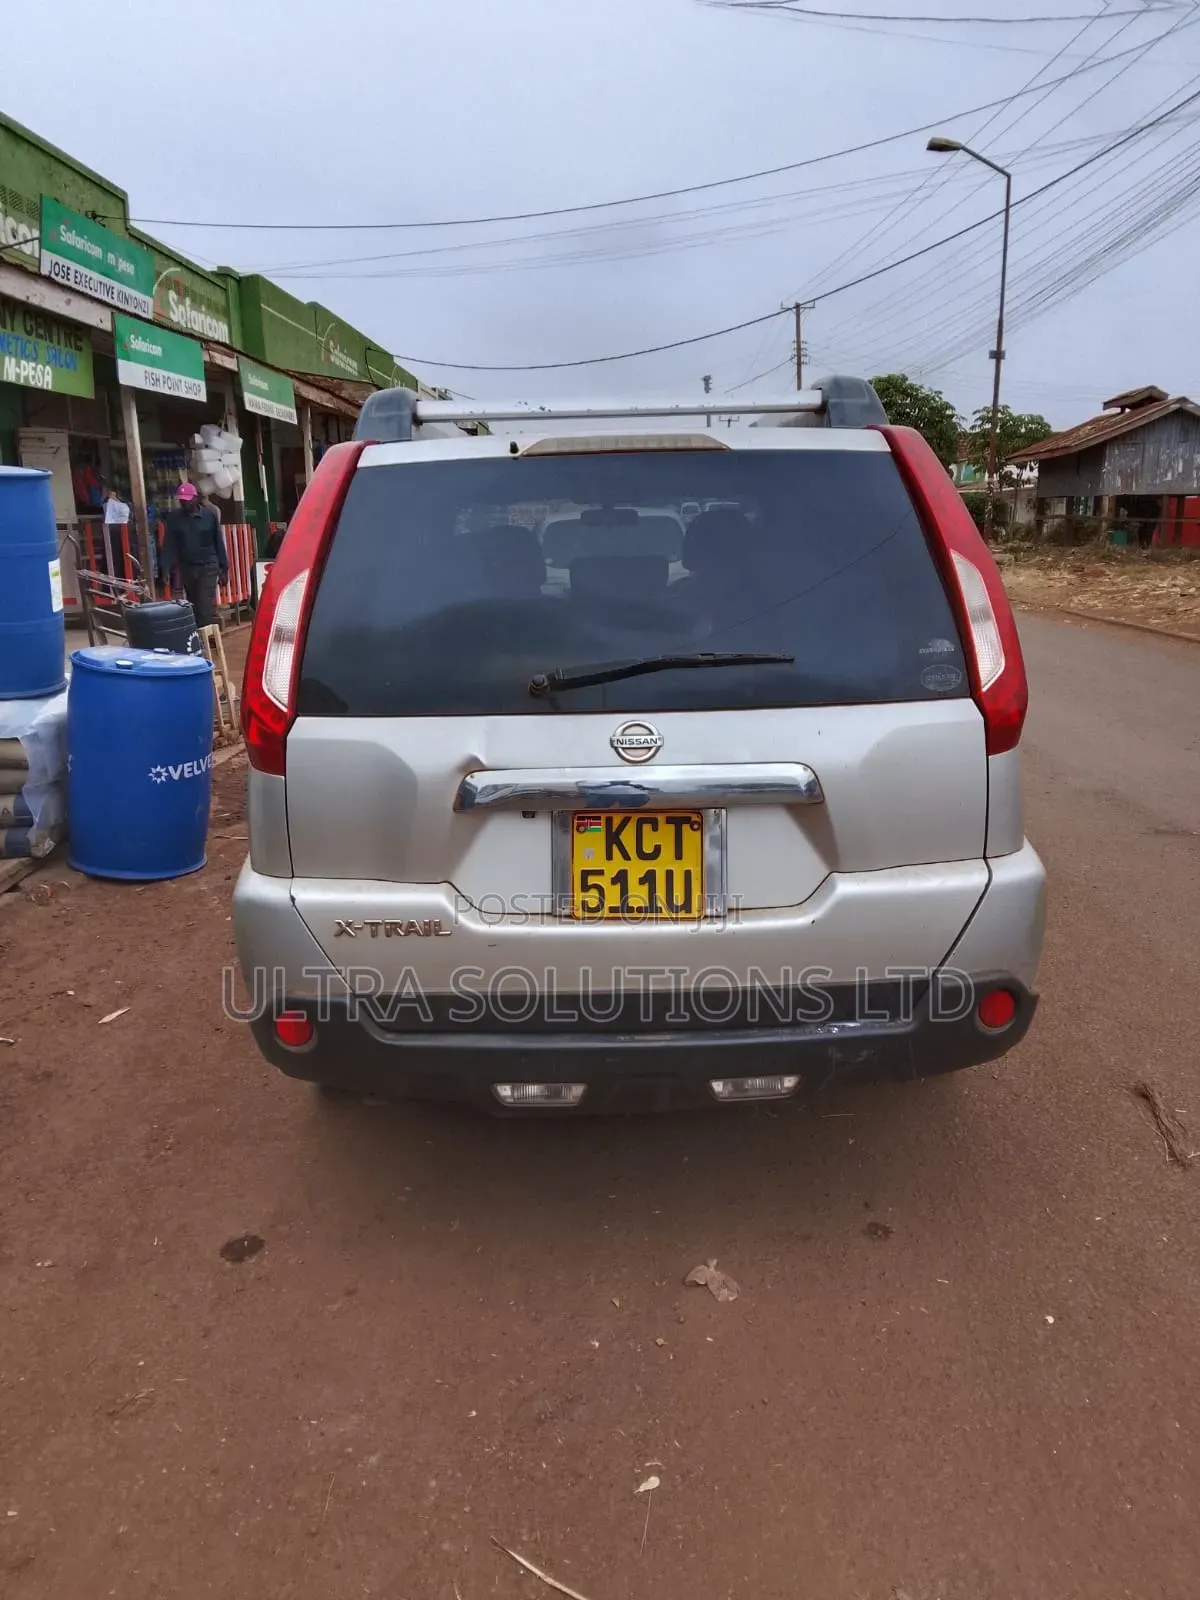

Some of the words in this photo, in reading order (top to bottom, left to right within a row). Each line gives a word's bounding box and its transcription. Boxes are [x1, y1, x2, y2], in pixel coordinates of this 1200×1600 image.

[60, 224, 103, 259] Safaricom
[48, 259, 71, 281] JOSE
[73, 269, 115, 300] EXECUTIVE
[168, 289, 229, 343] Safaricom
[130, 334, 162, 356] Safaricom
[4, 355, 52, 389] M-PESA
[144, 370, 161, 388] FISH
[184, 380, 202, 396] SHOP
[616, 737, 658, 746] NISSAN
[605, 816, 693, 861] KCT
[580, 868, 693, 914] 511U
[334, 919, 452, 938] X-TRAIL
